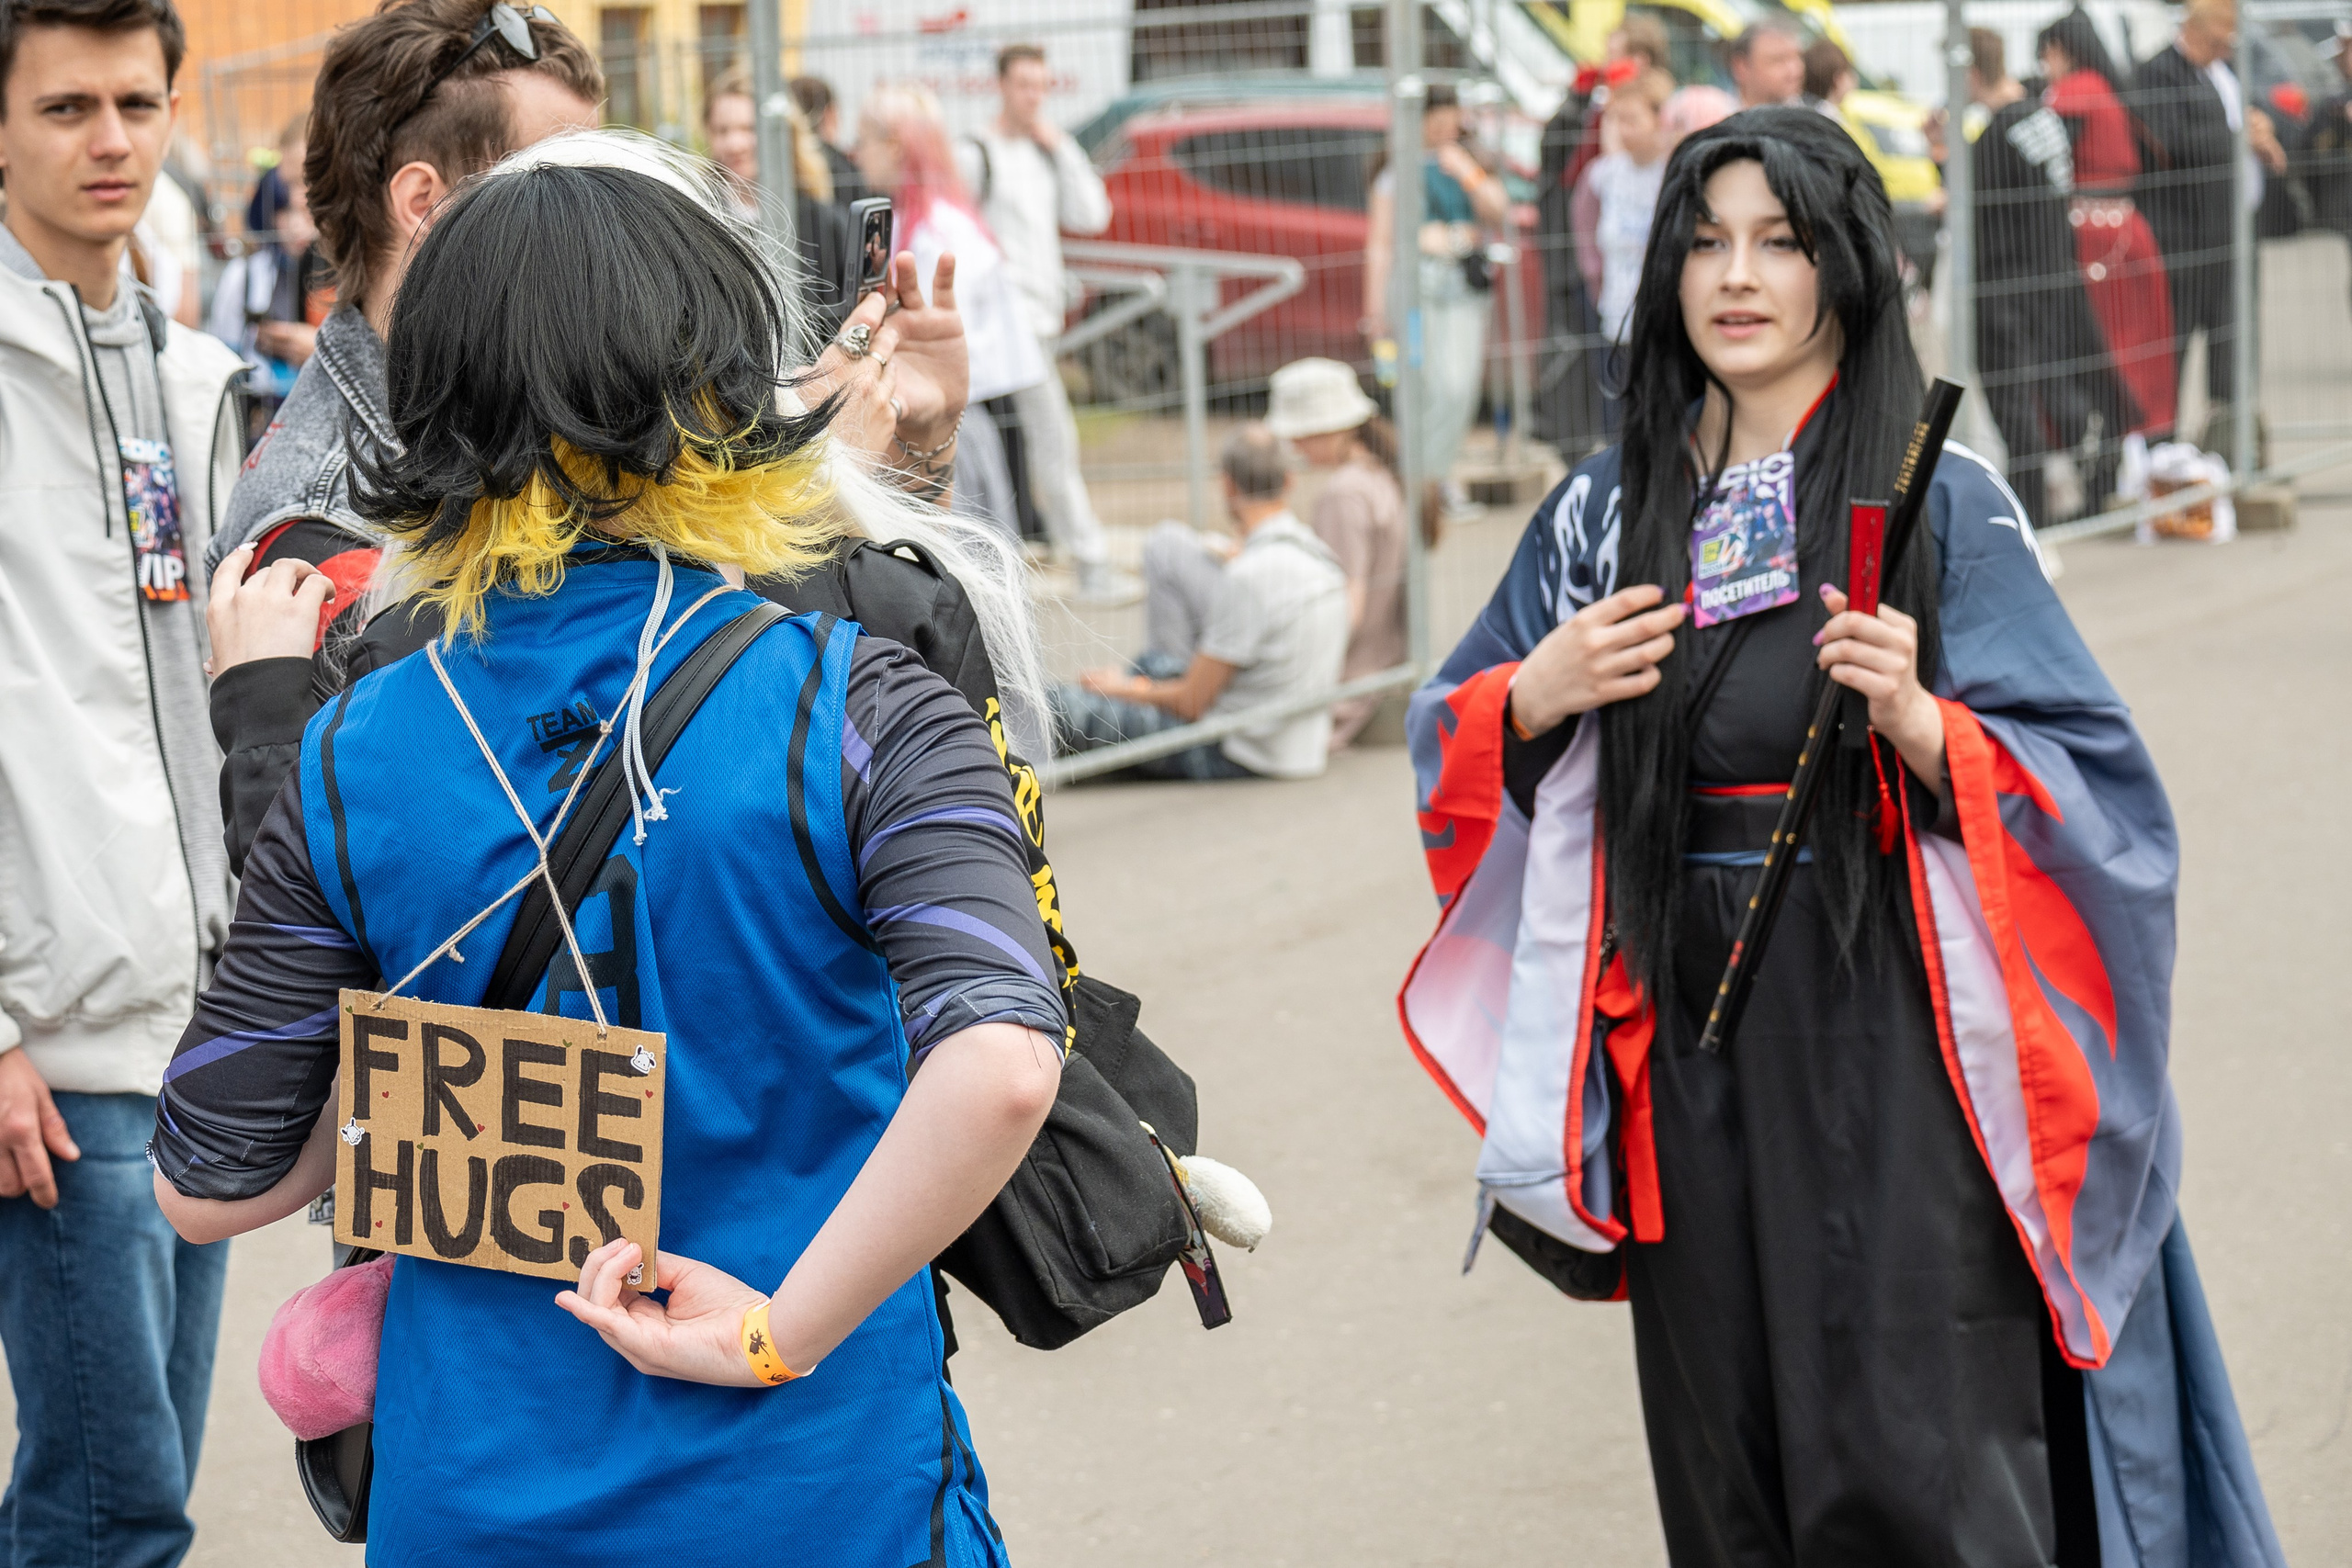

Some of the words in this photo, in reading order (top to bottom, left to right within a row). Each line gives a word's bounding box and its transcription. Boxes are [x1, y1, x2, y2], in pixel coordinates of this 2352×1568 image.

[1701, 568, 1791, 610] ПОСЕТИТЕЛЬ
[353, 1014, 649, 1163] FREE
[353, 1132, 645, 1269] HUGS
